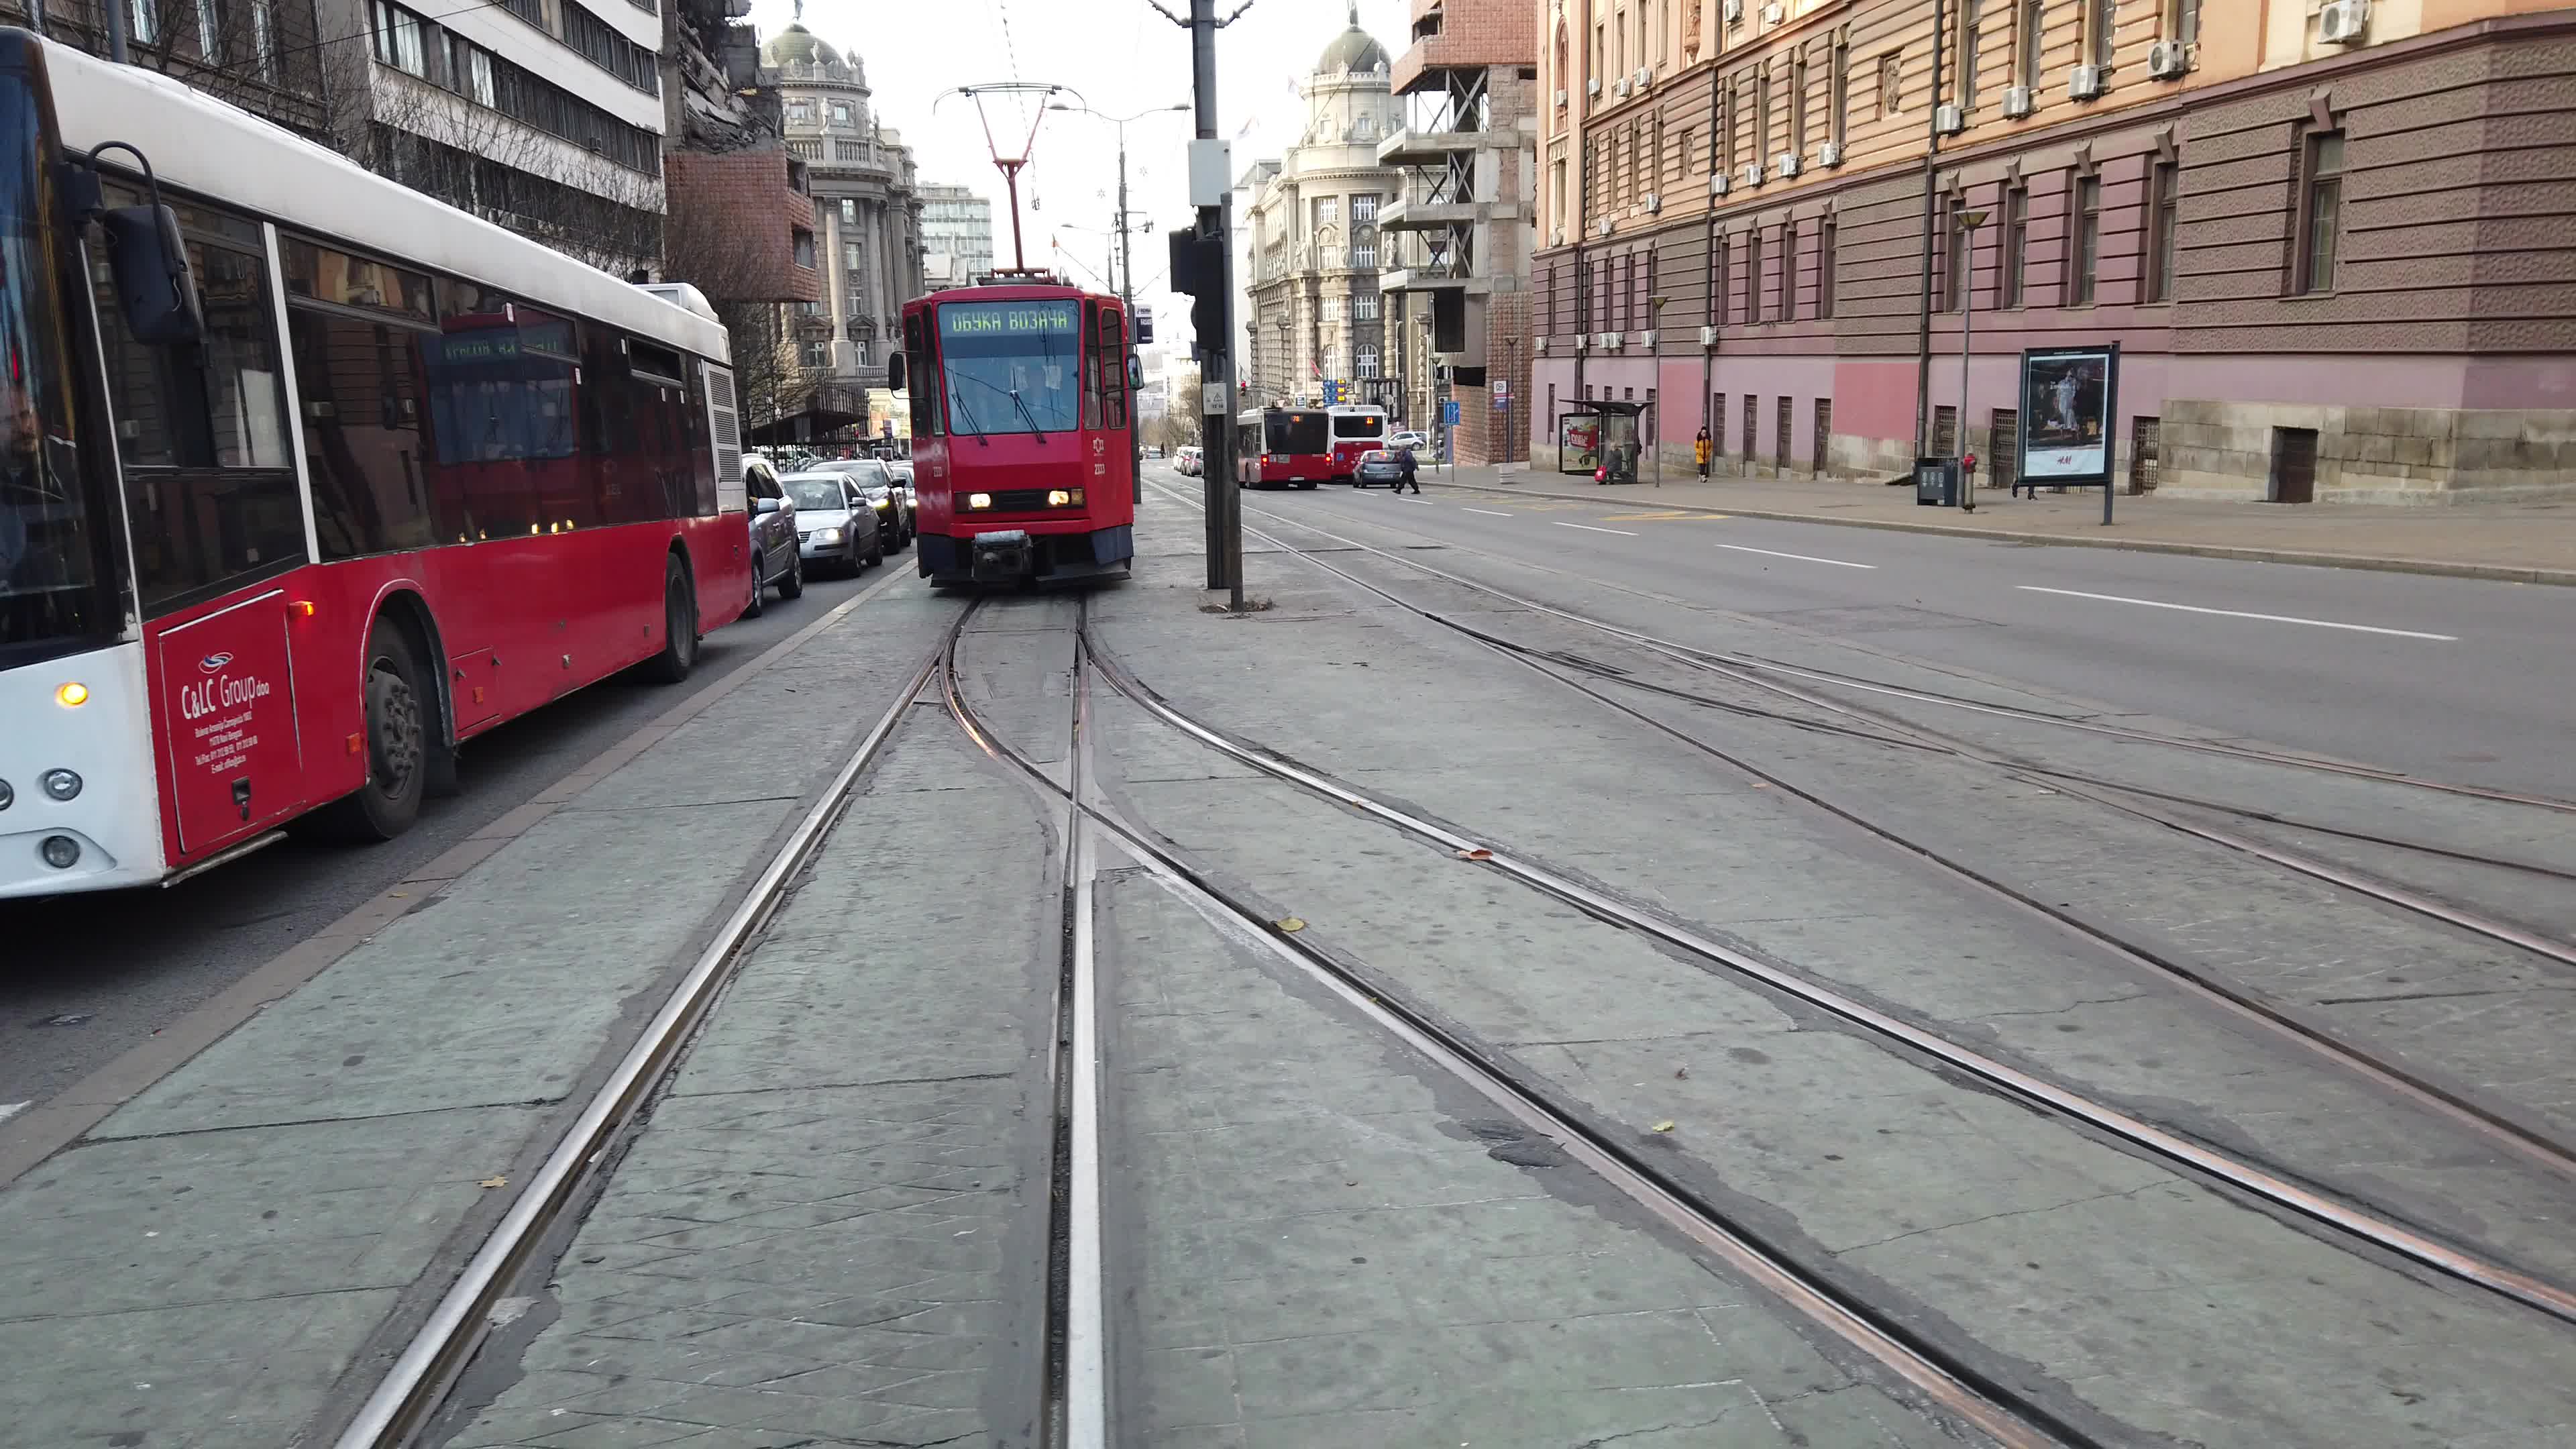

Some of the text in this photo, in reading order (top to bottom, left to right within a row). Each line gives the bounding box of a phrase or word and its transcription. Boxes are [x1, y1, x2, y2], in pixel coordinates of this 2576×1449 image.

[953, 310, 1067, 332] ОБУКА ВОЗАЧА
[182, 674, 270, 720] C&LC Group doo
